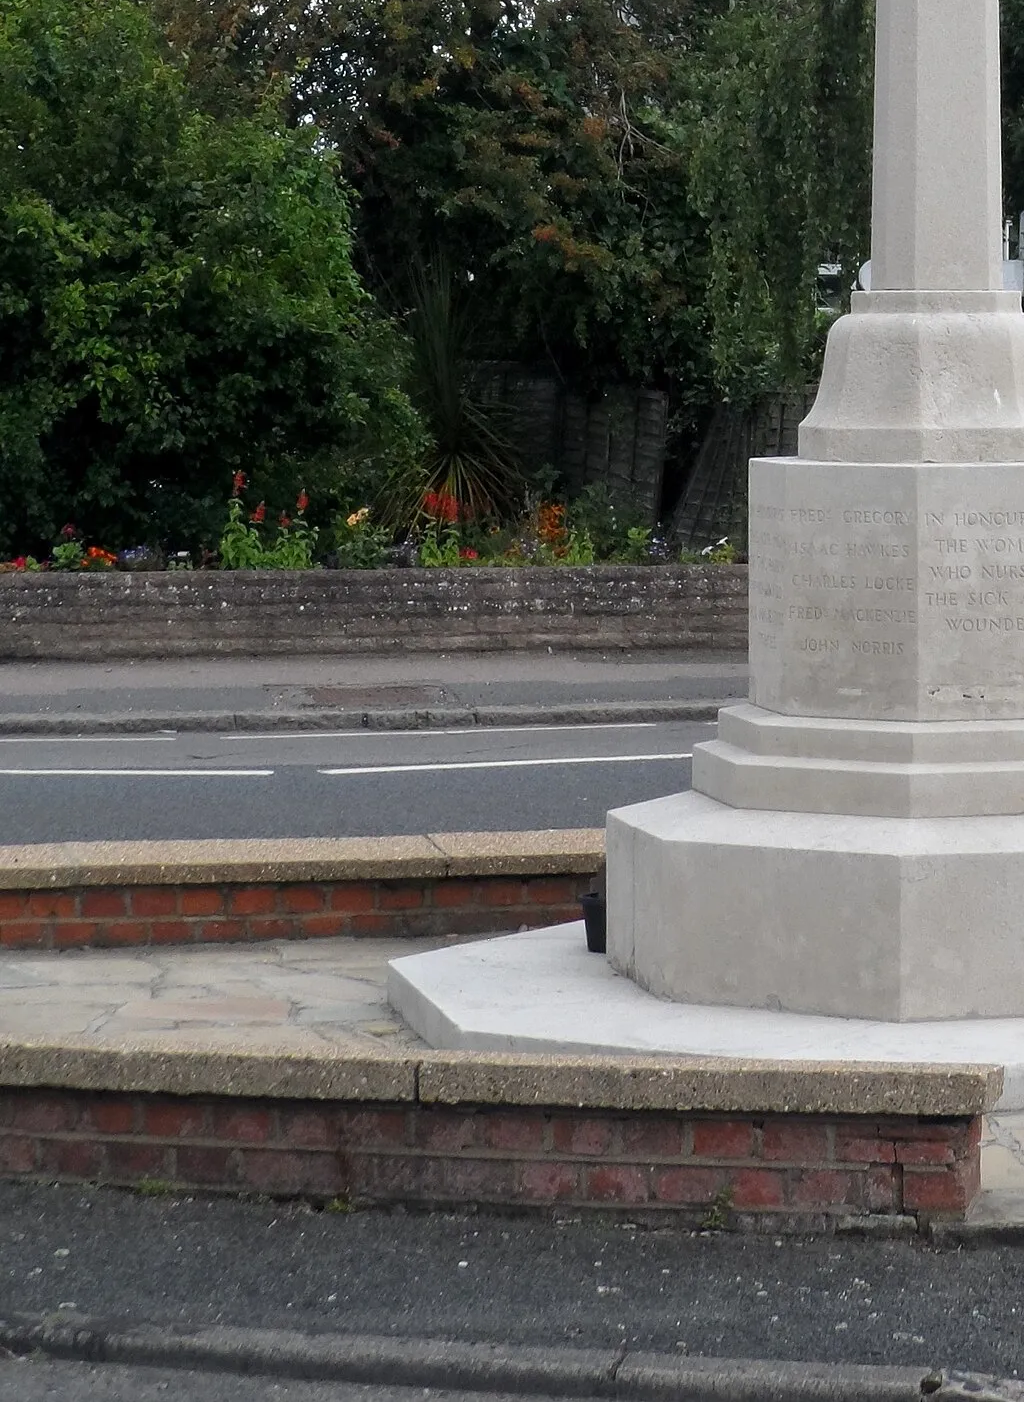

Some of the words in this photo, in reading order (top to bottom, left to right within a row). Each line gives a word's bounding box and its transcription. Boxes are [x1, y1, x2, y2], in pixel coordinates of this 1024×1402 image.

[842, 510, 913, 526] GREGORY
[924, 511, 945, 526] IN
[934, 538, 968, 553] THE
[928, 564, 972, 580] WHO
[792, 574, 857, 589] CHARLES
[865, 576, 915, 591] LOCKE
[925, 591, 958, 606] THE
[967, 590, 1009, 606] SICK
[800, 638, 840, 652] JOHN
[852, 641, 905, 655] NORRIS
